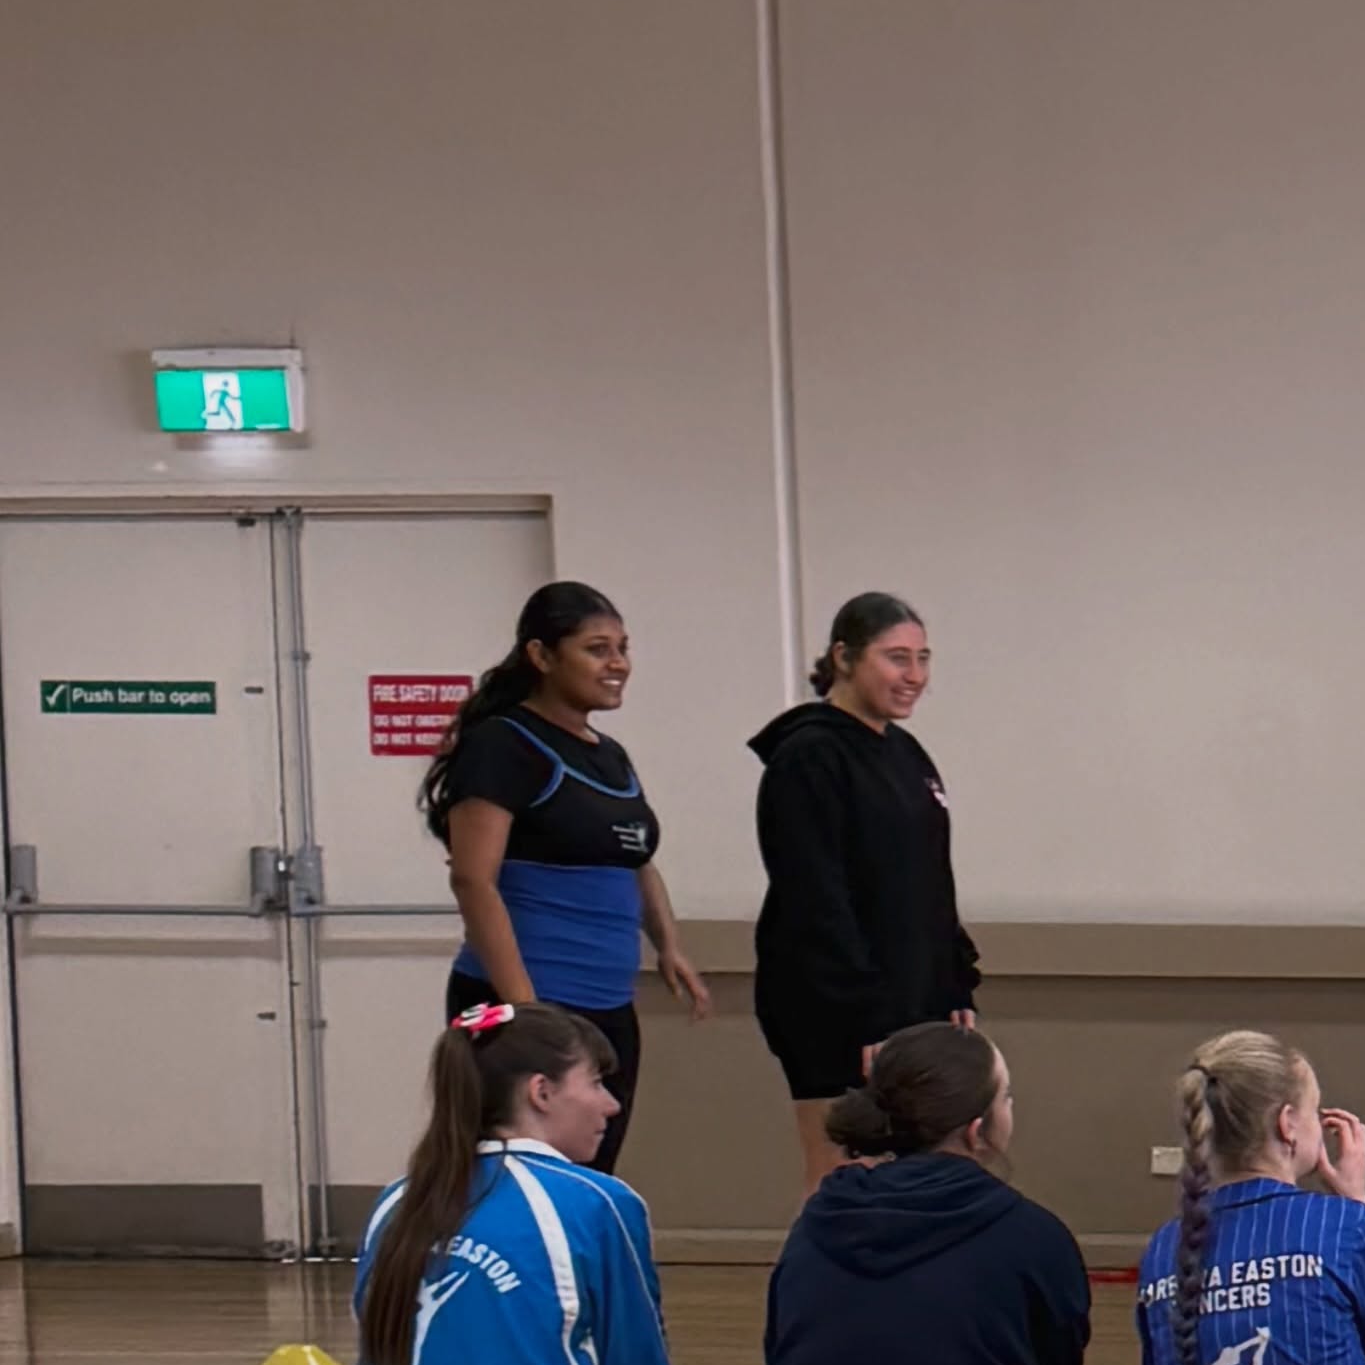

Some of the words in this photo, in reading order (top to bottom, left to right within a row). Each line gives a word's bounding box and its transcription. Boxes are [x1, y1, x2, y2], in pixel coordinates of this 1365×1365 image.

[72, 687, 113, 703] Push
[118, 688, 145, 704] bar
[151, 689, 166, 704] to
[169, 690, 211, 707] open
[445, 1235, 522, 1294] EASTON
[1231, 1253, 1324, 1285] EASTON
[1172, 1282, 1272, 1315] NCERS
